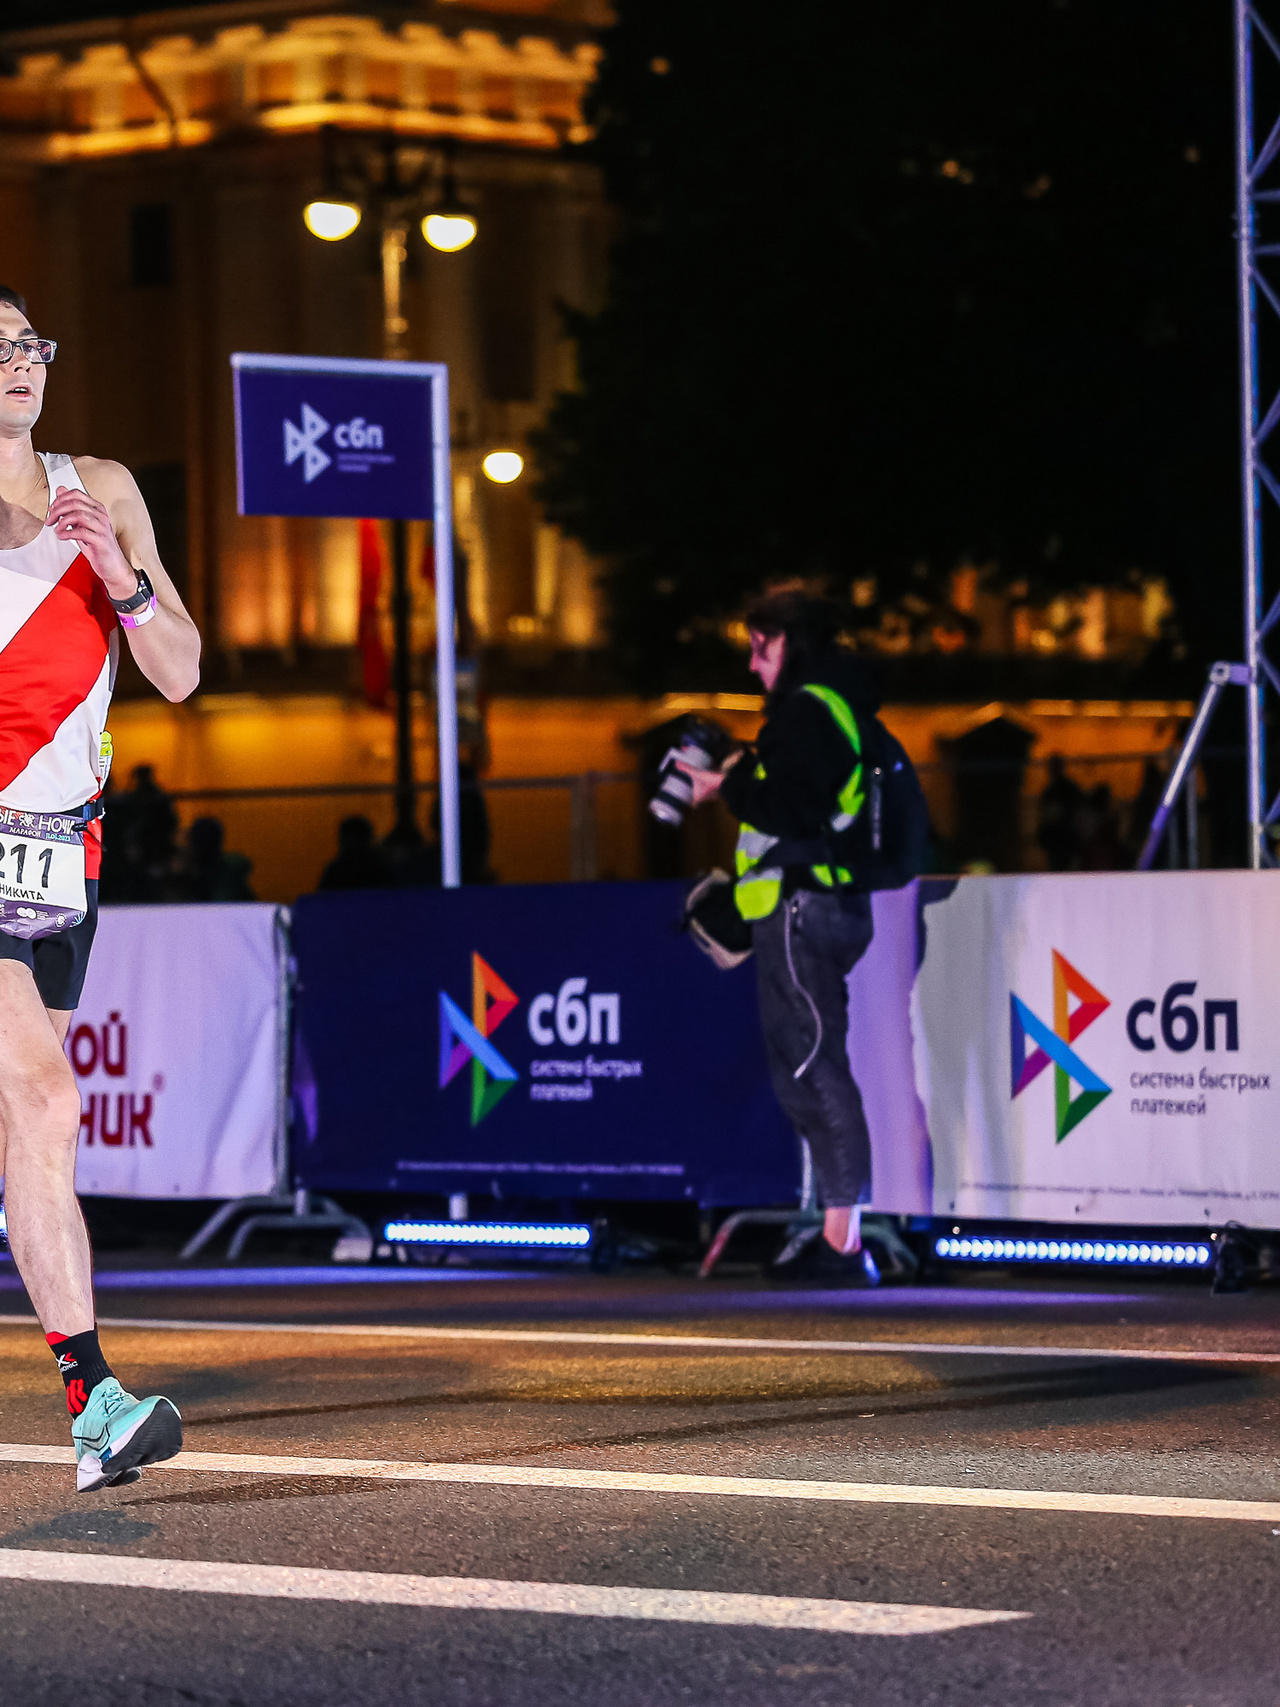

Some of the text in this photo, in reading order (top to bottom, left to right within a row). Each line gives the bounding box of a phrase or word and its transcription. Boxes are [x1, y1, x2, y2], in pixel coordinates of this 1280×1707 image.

[9, 827, 42, 838] МАРАФОН
[1130, 1066, 1270, 1094] система быстрых
[1130, 1094, 1206, 1116] платежей
